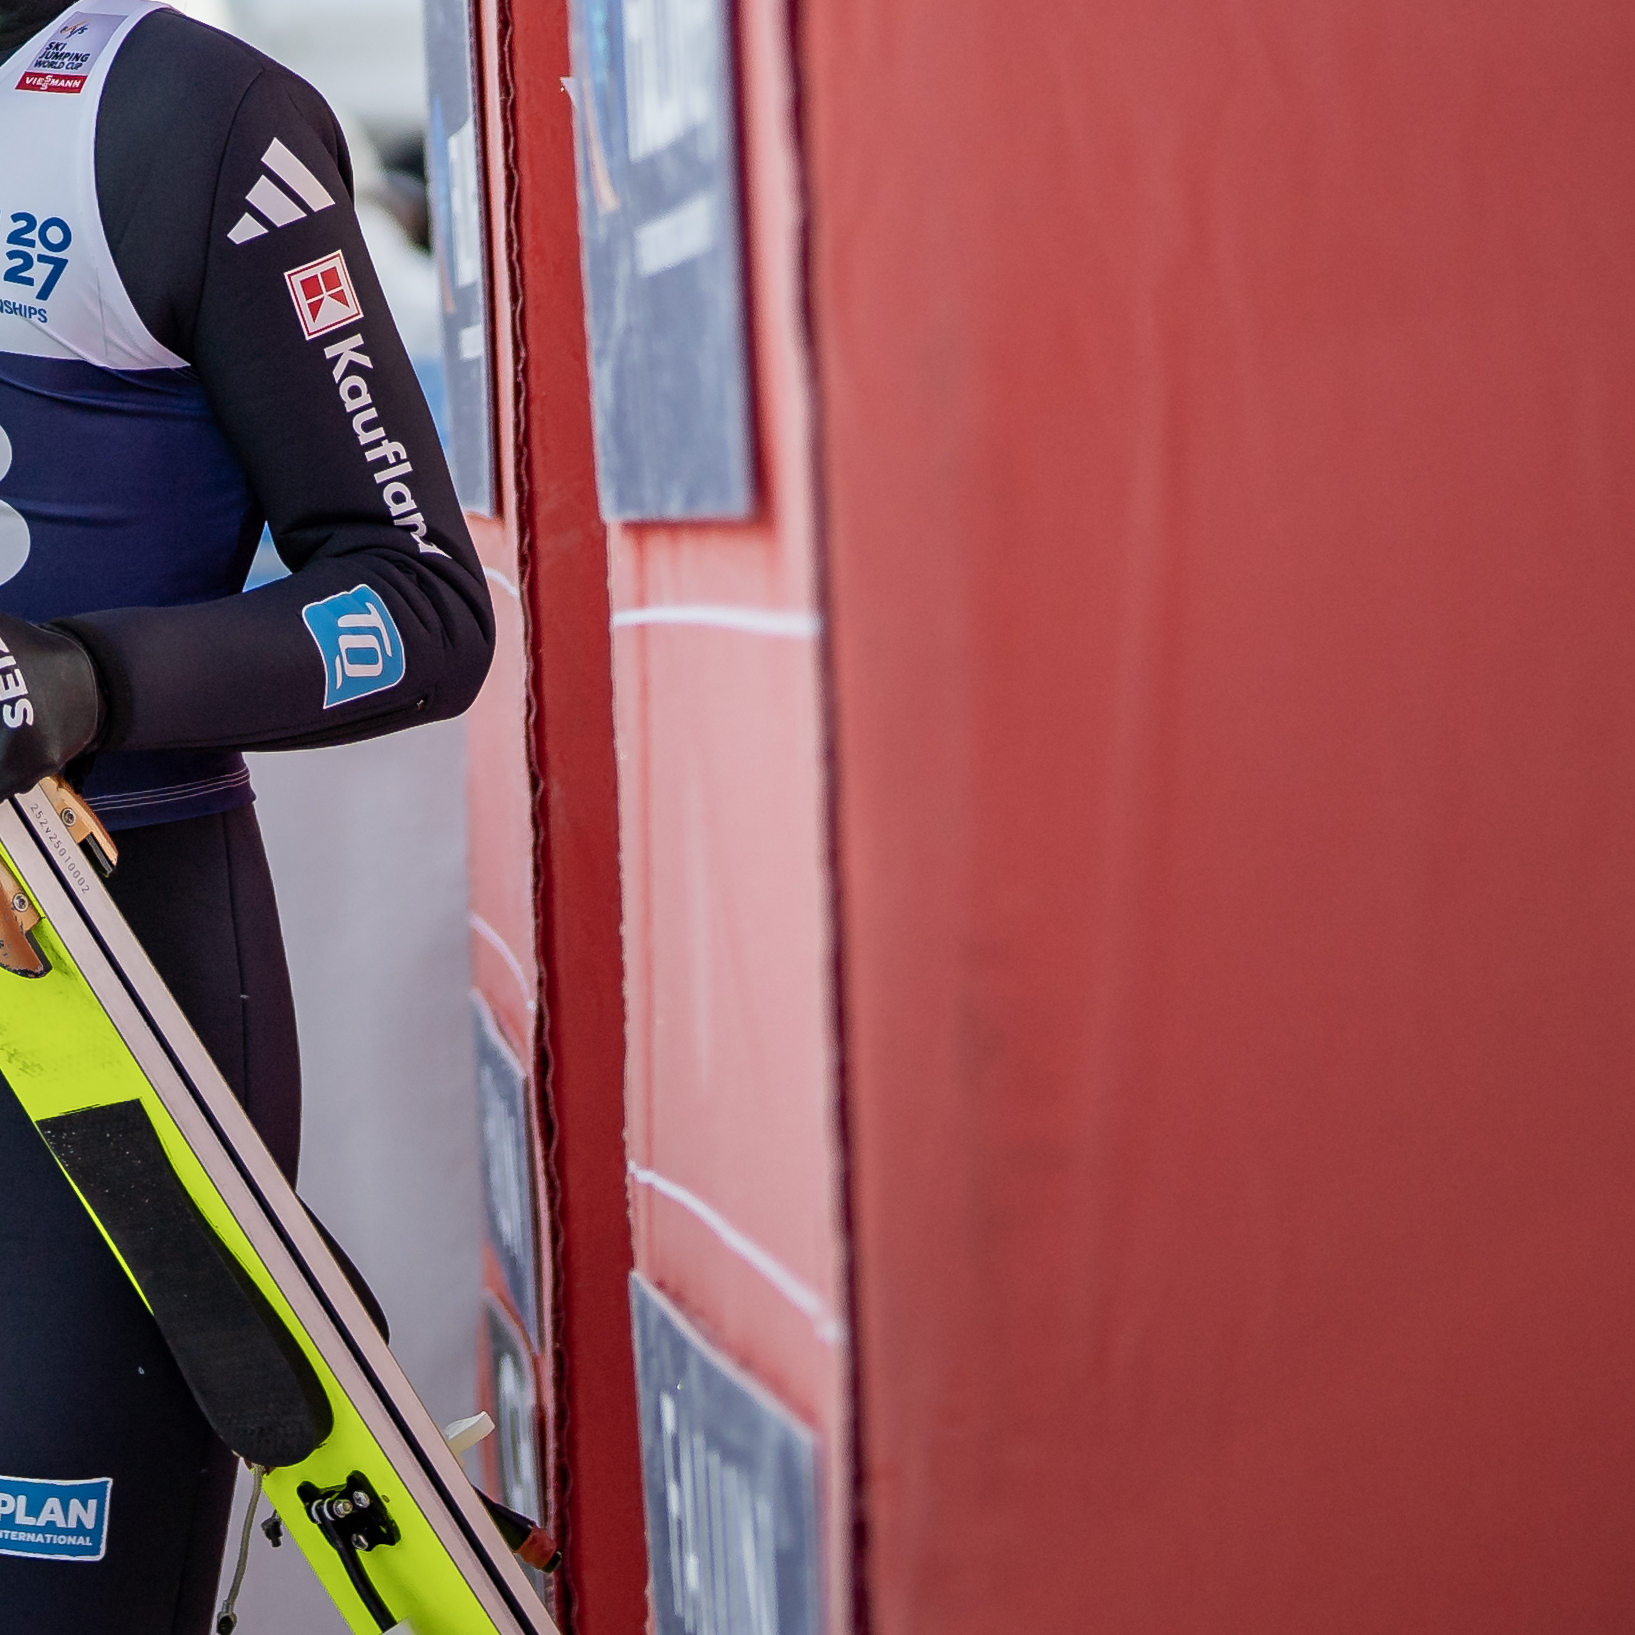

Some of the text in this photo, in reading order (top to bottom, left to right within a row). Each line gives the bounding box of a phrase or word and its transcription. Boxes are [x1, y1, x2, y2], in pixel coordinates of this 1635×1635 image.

[38, 50, 90, 63] JUMPING
[45, 41, 67, 52] SKI
[6, 211, 73, 253] 20
[3, 250, 69, 301] 27
